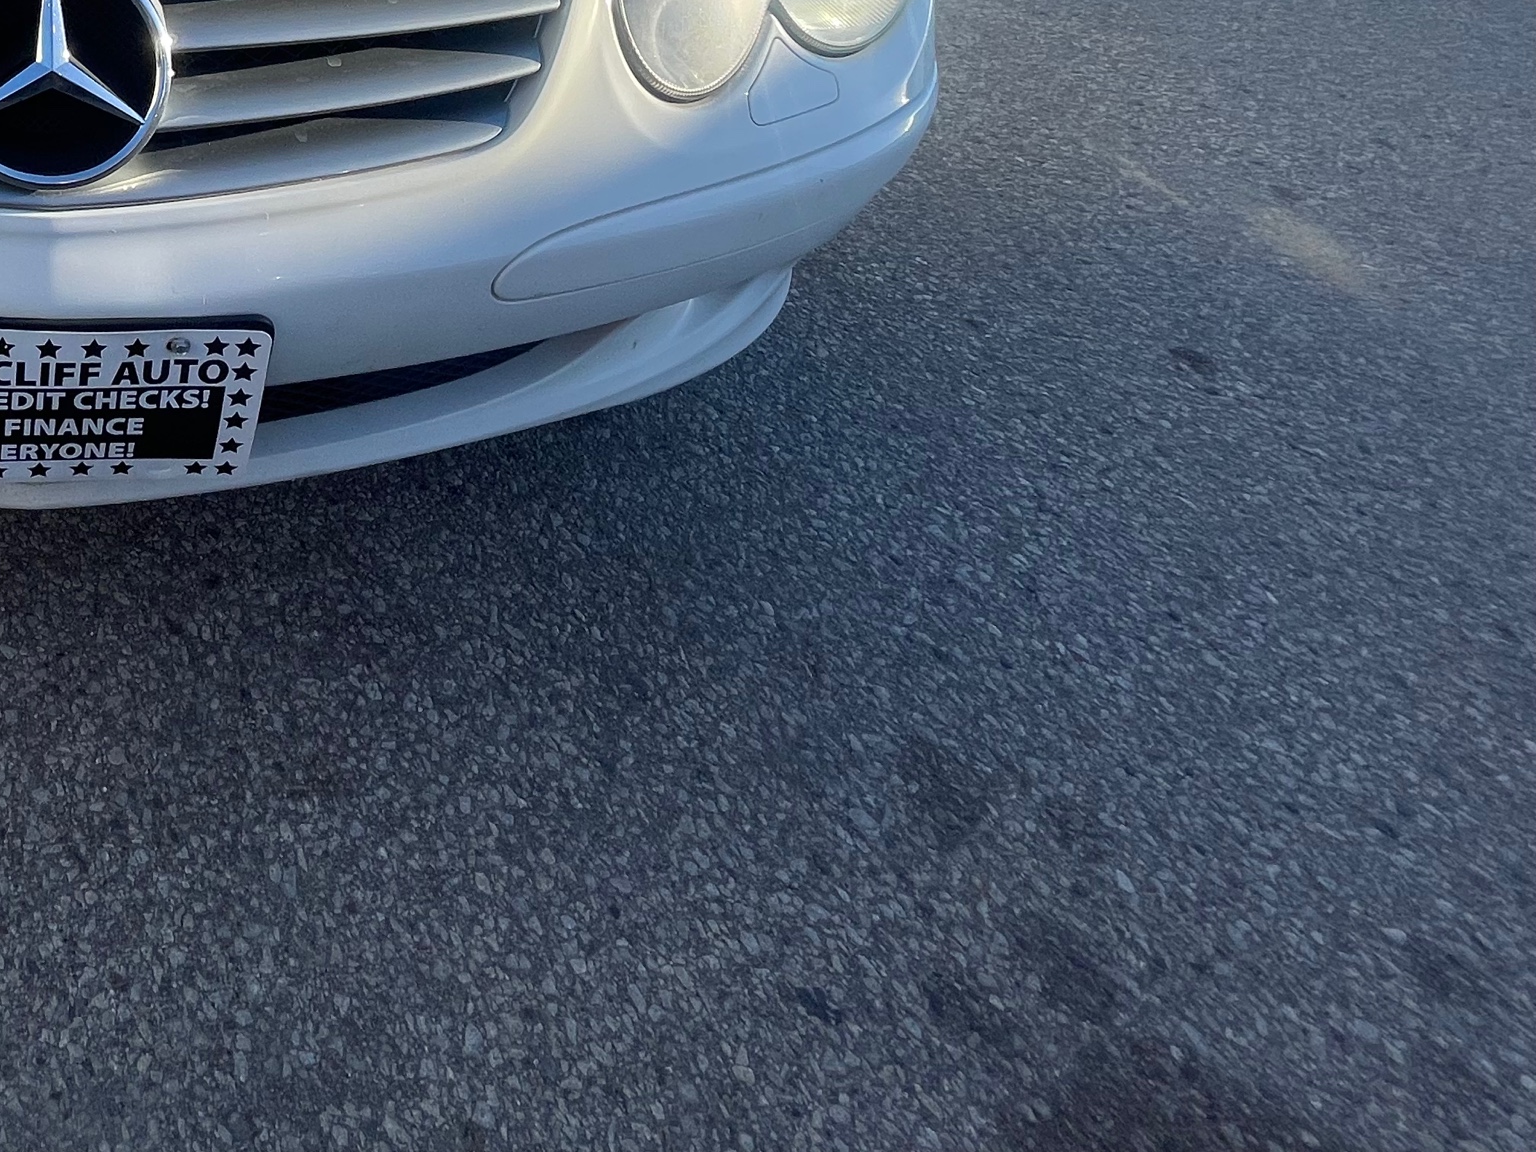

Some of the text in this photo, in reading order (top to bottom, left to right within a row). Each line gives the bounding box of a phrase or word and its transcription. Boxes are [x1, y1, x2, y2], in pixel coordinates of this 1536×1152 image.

[111, 359, 230, 386] AUTO
[73, 389, 211, 410] CHECKS!
[4, 417, 145, 437] FINANCE
